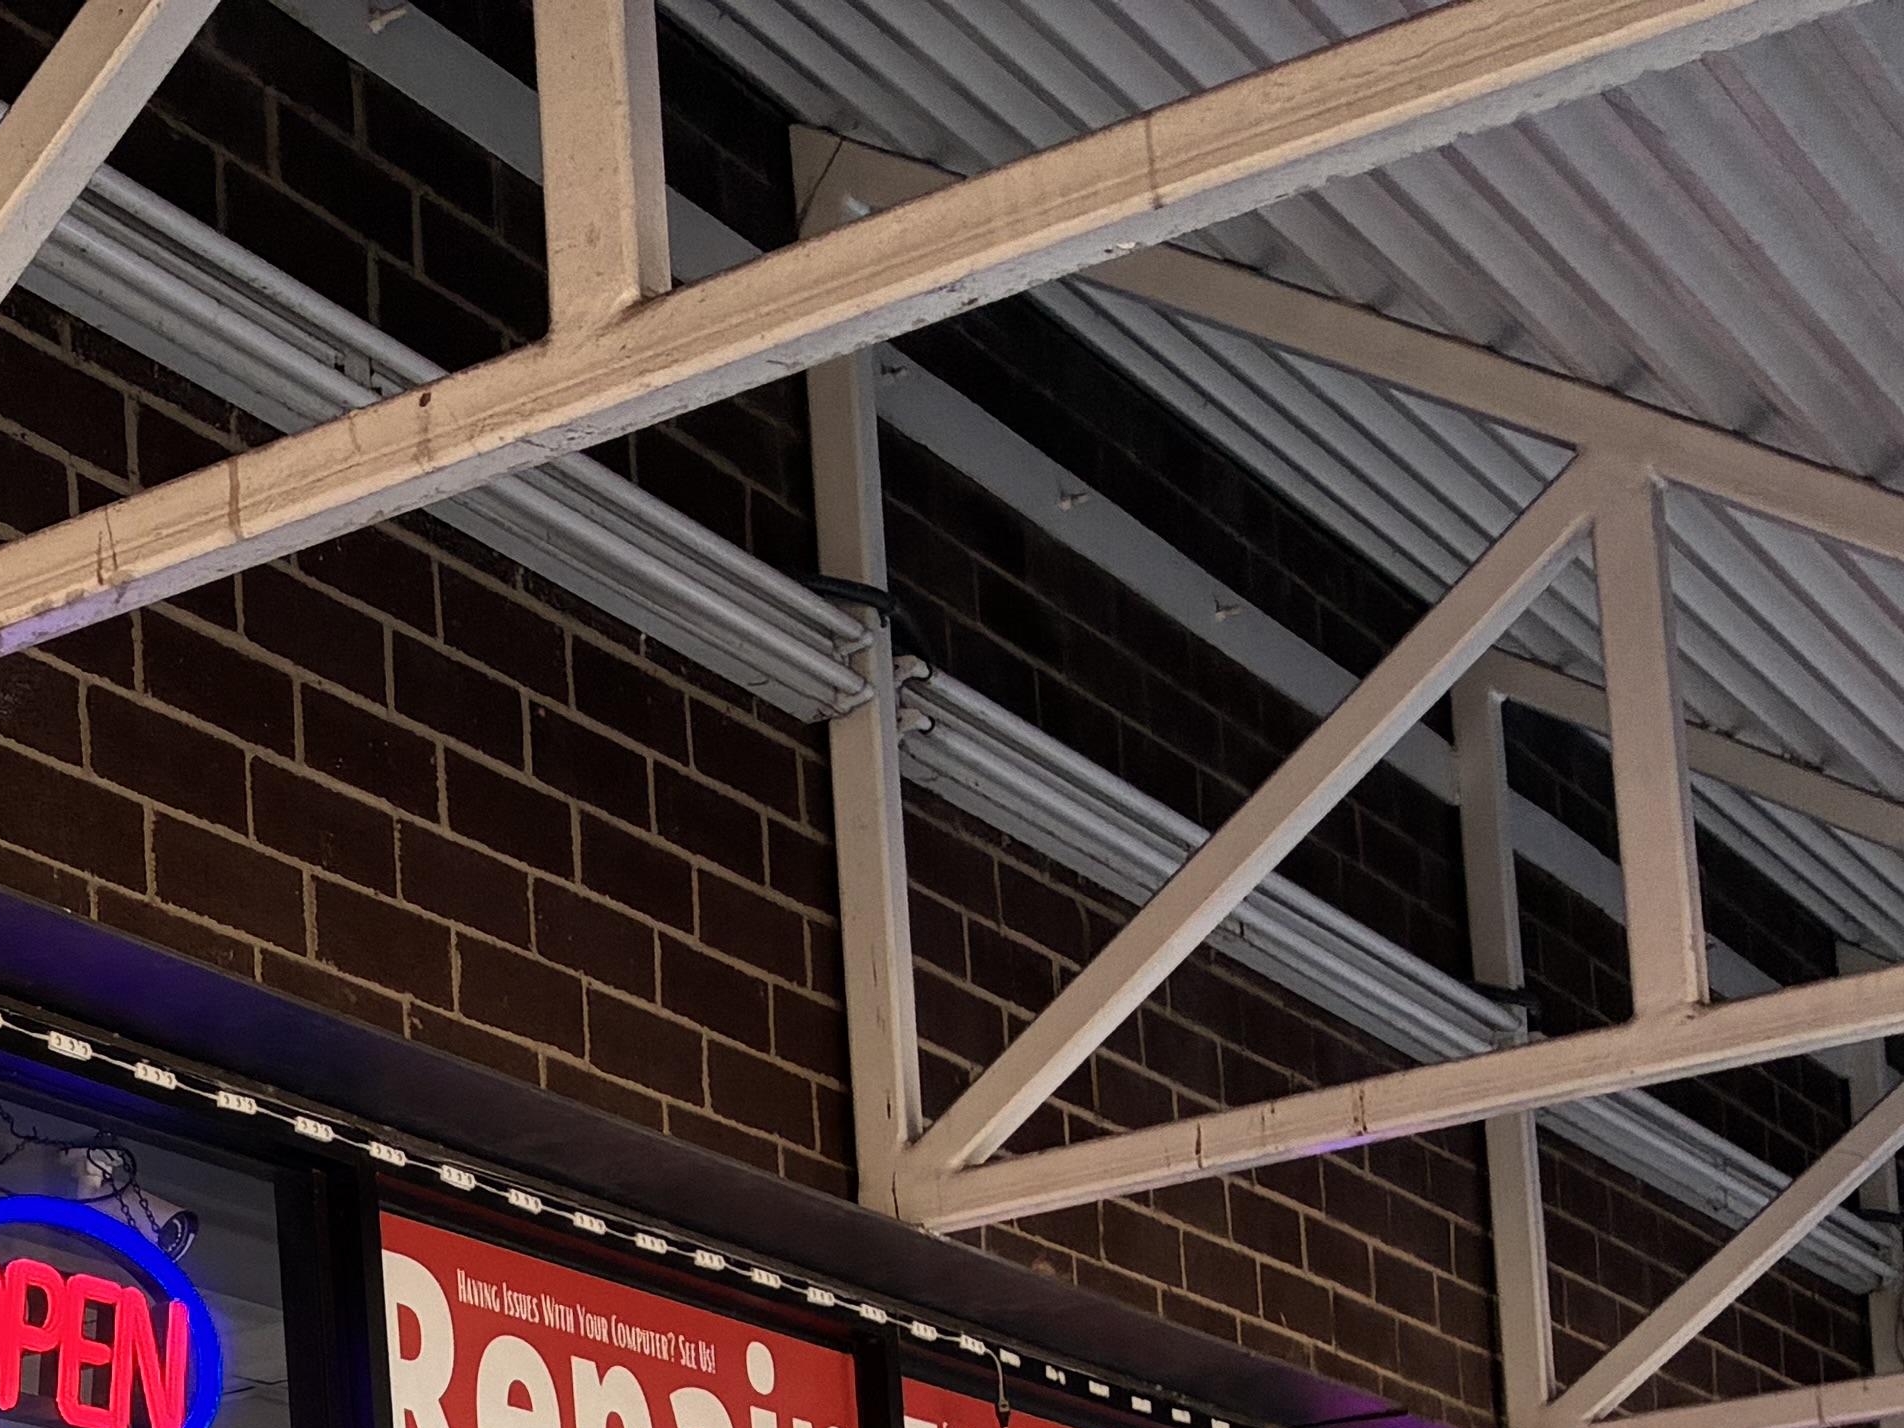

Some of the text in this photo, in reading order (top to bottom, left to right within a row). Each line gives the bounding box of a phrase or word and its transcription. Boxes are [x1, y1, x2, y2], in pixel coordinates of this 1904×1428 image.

[456, 1268, 716, 1374] HAVING ISSUES WITH YOUR COMPUTER? SEE US!
